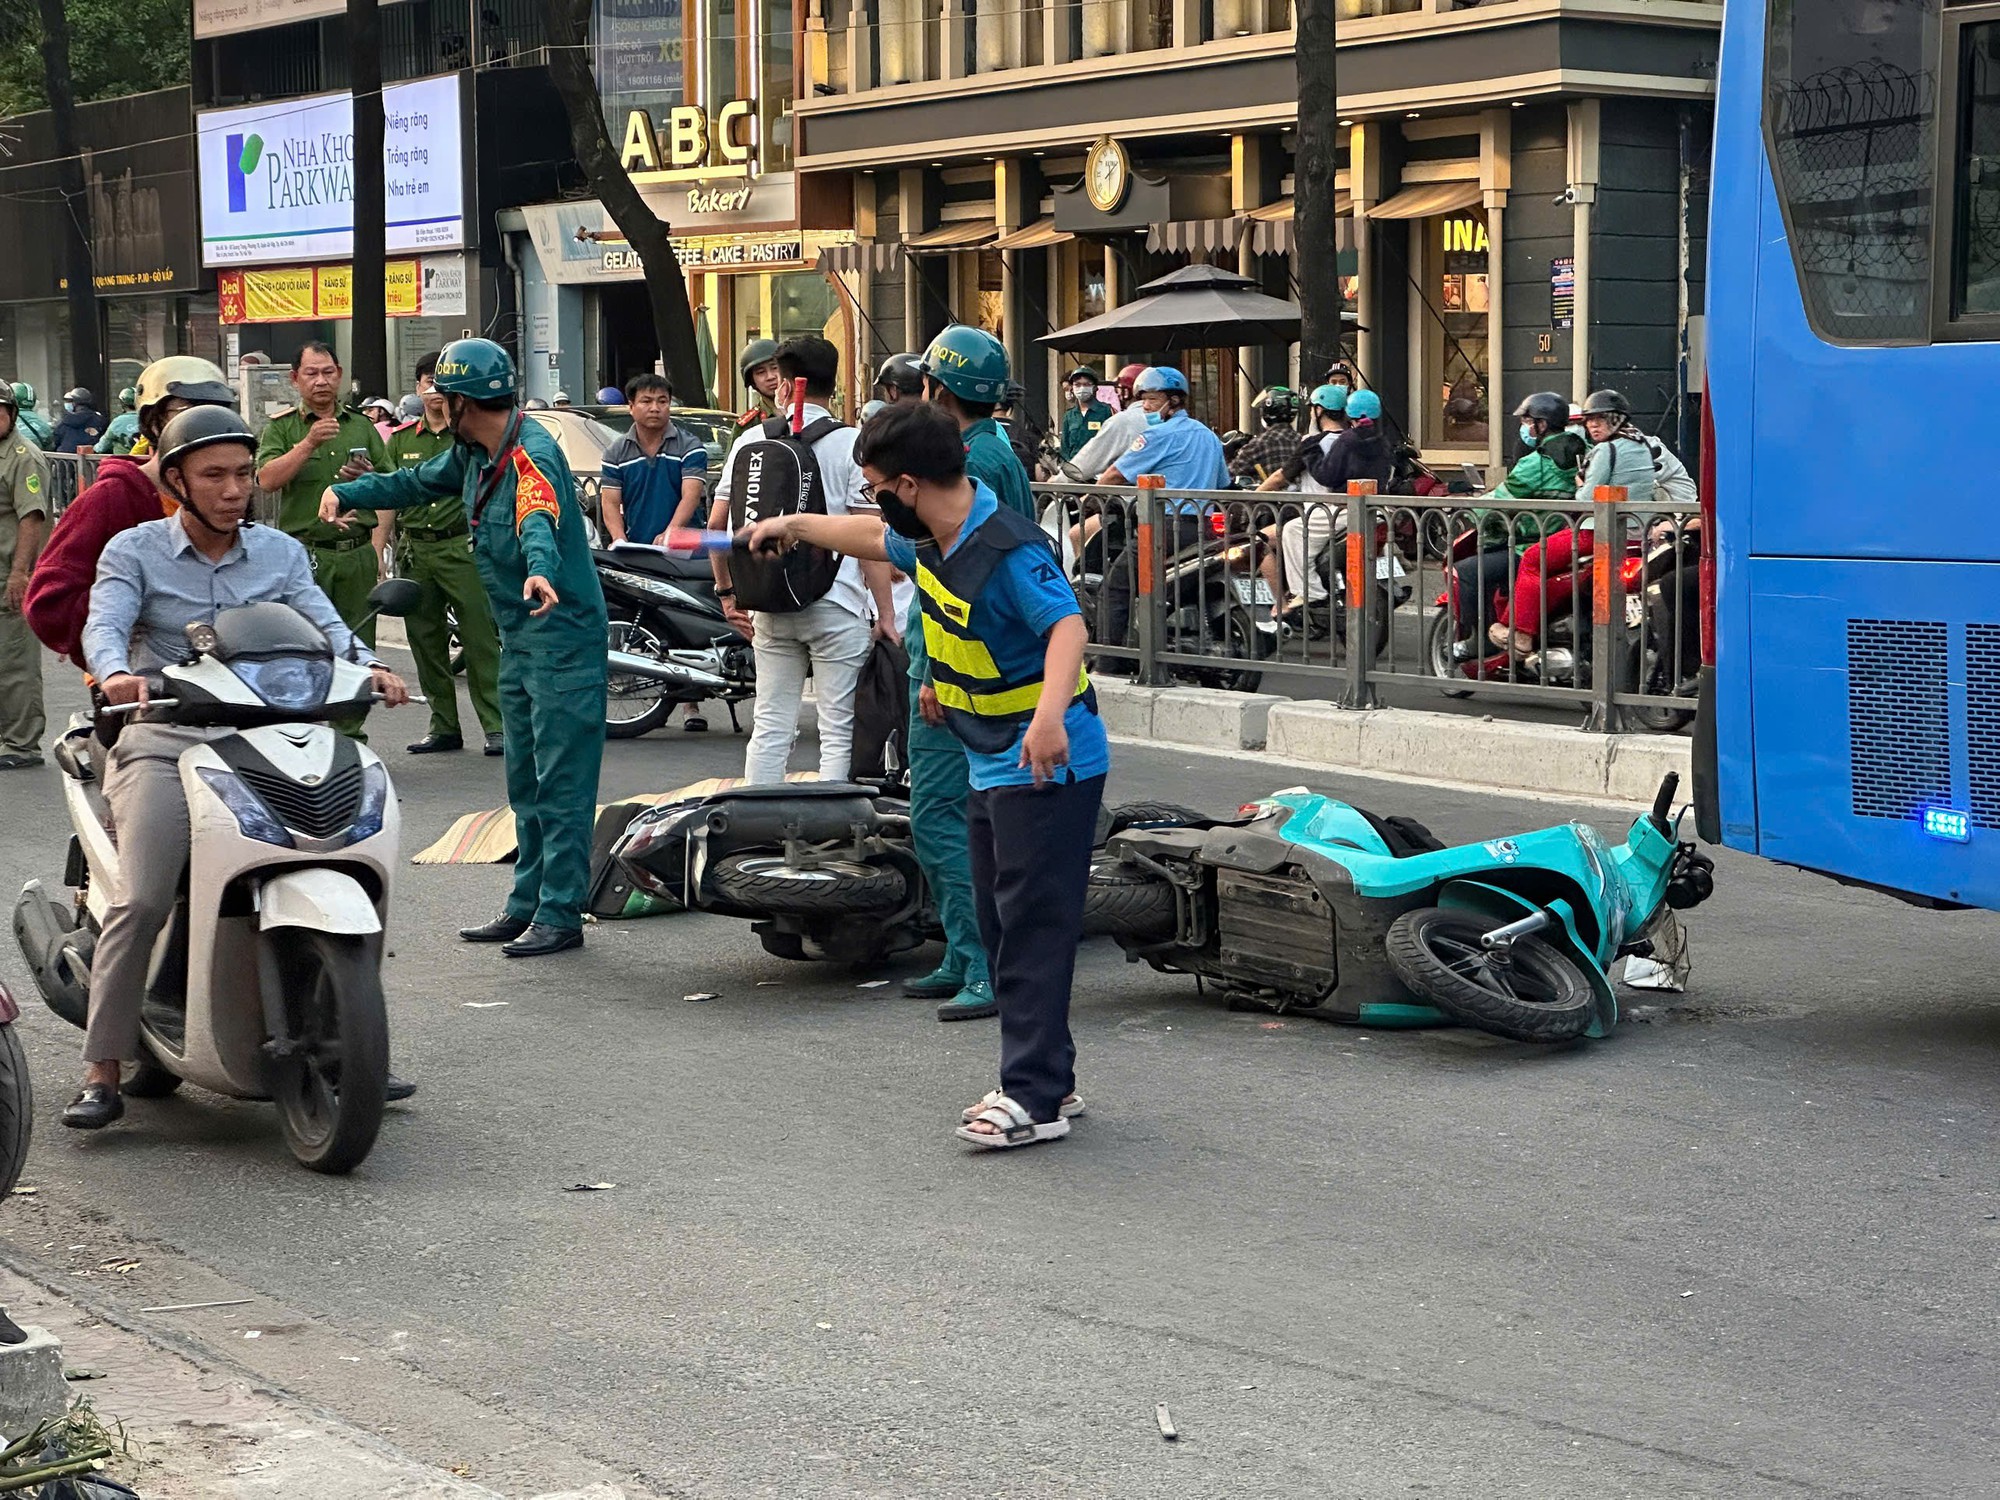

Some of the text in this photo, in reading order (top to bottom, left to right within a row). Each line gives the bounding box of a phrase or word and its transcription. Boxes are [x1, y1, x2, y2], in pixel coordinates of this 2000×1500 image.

[386, 110, 428, 133] Niềng răng
[620, 100, 748, 169] ABC
[283, 133, 353, 169] NHA KHO
[387, 145, 428, 167] Trồng răng
[266, 152, 353, 210] PARKWA
[388, 178, 429, 197] Nha trẻ em
[687, 187, 750, 213] Bakery
[673, 248, 701, 266] FEE
[710, 245, 742, 264] CAKE
[750, 242, 796, 262] PASTRY
[95, 275, 116, 289] QUANG
[116, 273, 135, 285] TRUNG
[152, 268, 161, 282] GÒ
[162, 266, 174, 281] VẤP
[221, 277, 239, 295] Deal
[276, 281, 286, 291] CAO
[296, 279, 310, 290] RĂNG
[388, 271, 405, 284] RĂNG
[224, 296, 238, 316] sốc
[328, 294, 333, 306] 3
[334, 292, 349, 309] triệu
[551, 354, 557, 365] 2
[930, 344, 968, 368] DQTV
[437, 363, 469, 376] DQTV
[746, 451, 764, 506] YONEX
[800, 471, 813, 512] ONEX
